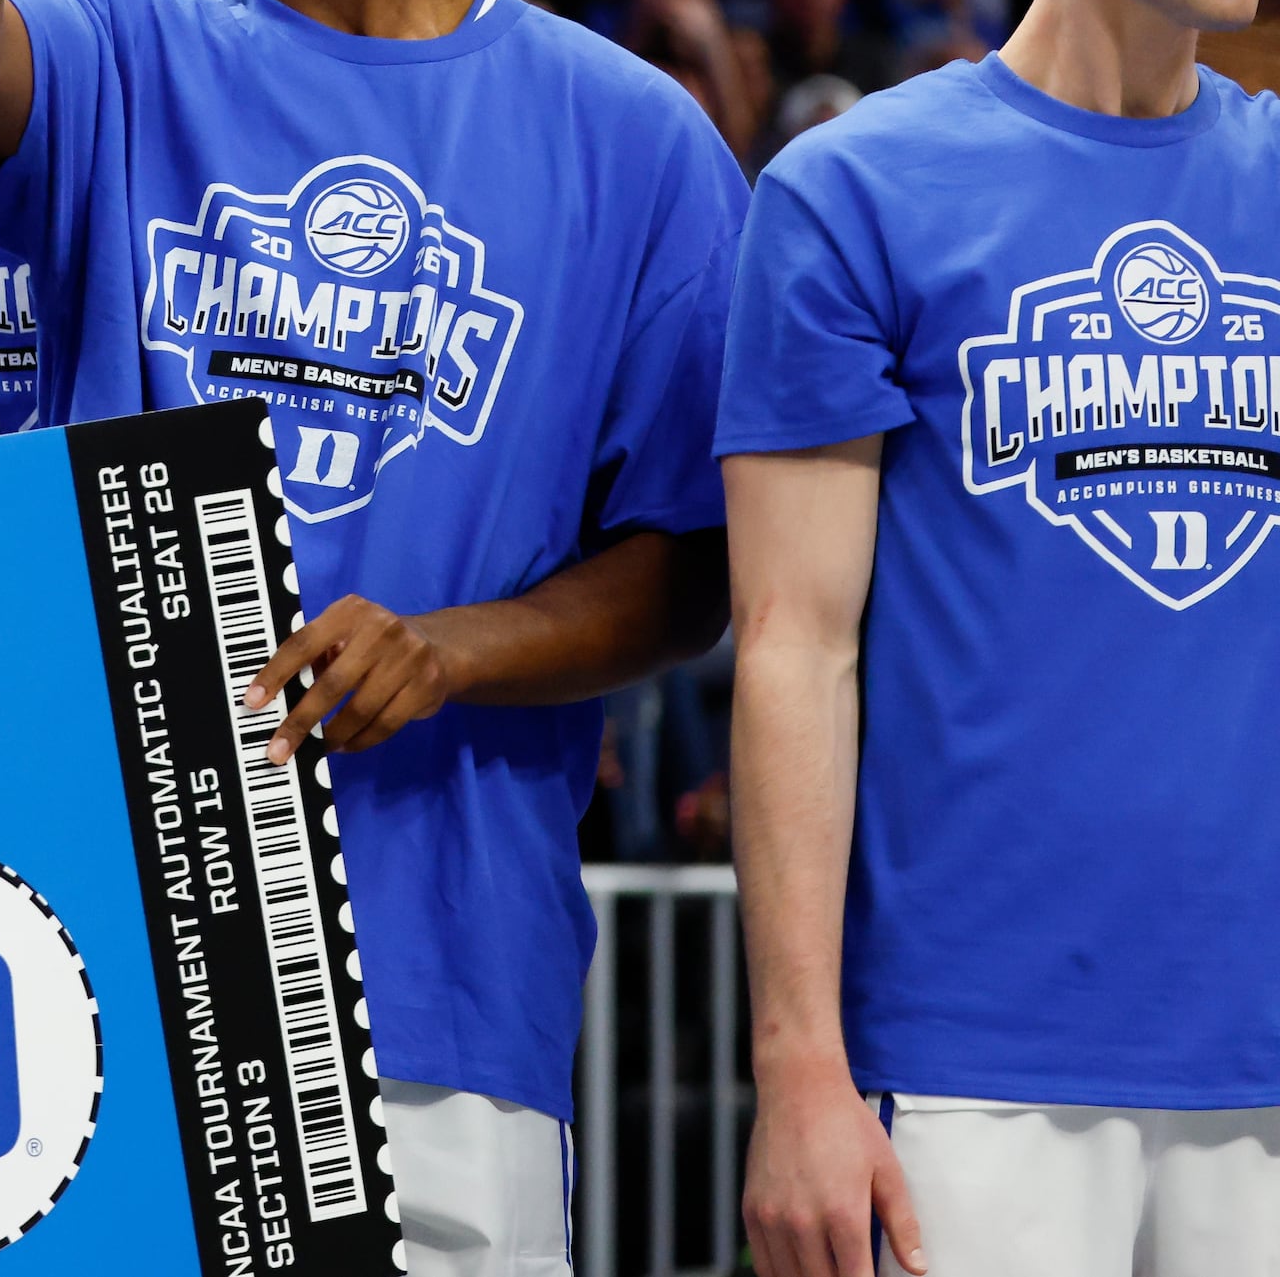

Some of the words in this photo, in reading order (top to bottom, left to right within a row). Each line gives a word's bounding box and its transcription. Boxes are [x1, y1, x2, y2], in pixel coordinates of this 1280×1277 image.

[251, 228, 293, 261] 20
[319, 209, 406, 236] ACC
[1129, 276, 1200, 301] ACC
[1068, 313, 1113, 340] 20
[1221, 314, 1265, 342] 26
[230, 356, 298, 380] MEN'S
[285, 424, 361, 489] D
[1075, 449, 1141, 472] MEN'S
[1144, 448, 1269, 472] BASKETBALL
[140, 460, 175, 515] 26
[1056, 480, 1178, 504] ACCOMPLISH
[98, 463, 160, 671] QUALIFIER
[1148, 510, 1209, 570] D
[149, 525, 192, 621] SEAT
[133, 677, 197, 904] AUTOMATIC
[189, 766, 224, 816] 15
[198, 825, 240, 916] ROW
[170, 912, 238, 1175] TOURNAMENT
[236, 1058, 267, 1088] 3
[242, 1095, 296, 1269] SECTION
[213, 1178, 256, 1277] NCAA
